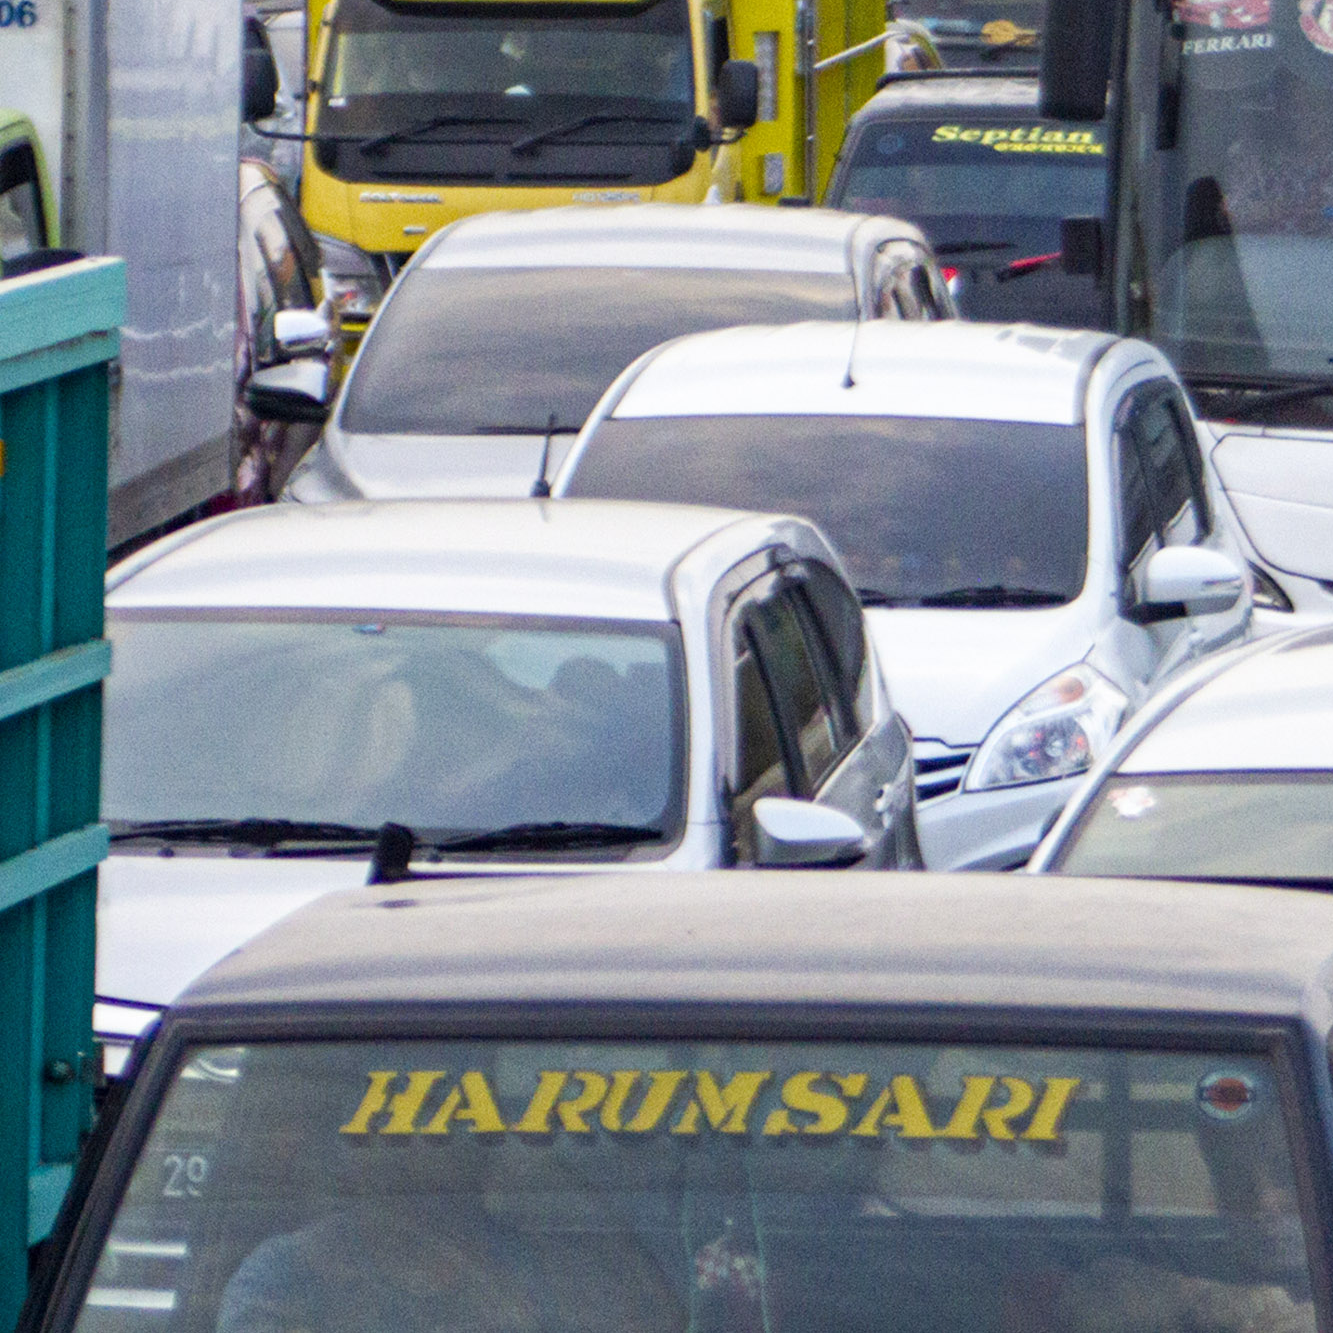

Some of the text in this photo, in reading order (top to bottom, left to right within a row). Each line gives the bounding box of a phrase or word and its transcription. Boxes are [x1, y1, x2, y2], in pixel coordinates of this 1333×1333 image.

[0, 0, 37, 29] 06
[1182, 33, 1273, 54] FERRARI
[932, 125, 1093, 145] Septian
[339, 1069, 1083, 1141] HARUMSARI
[162, 1153, 209, 1197] 29
